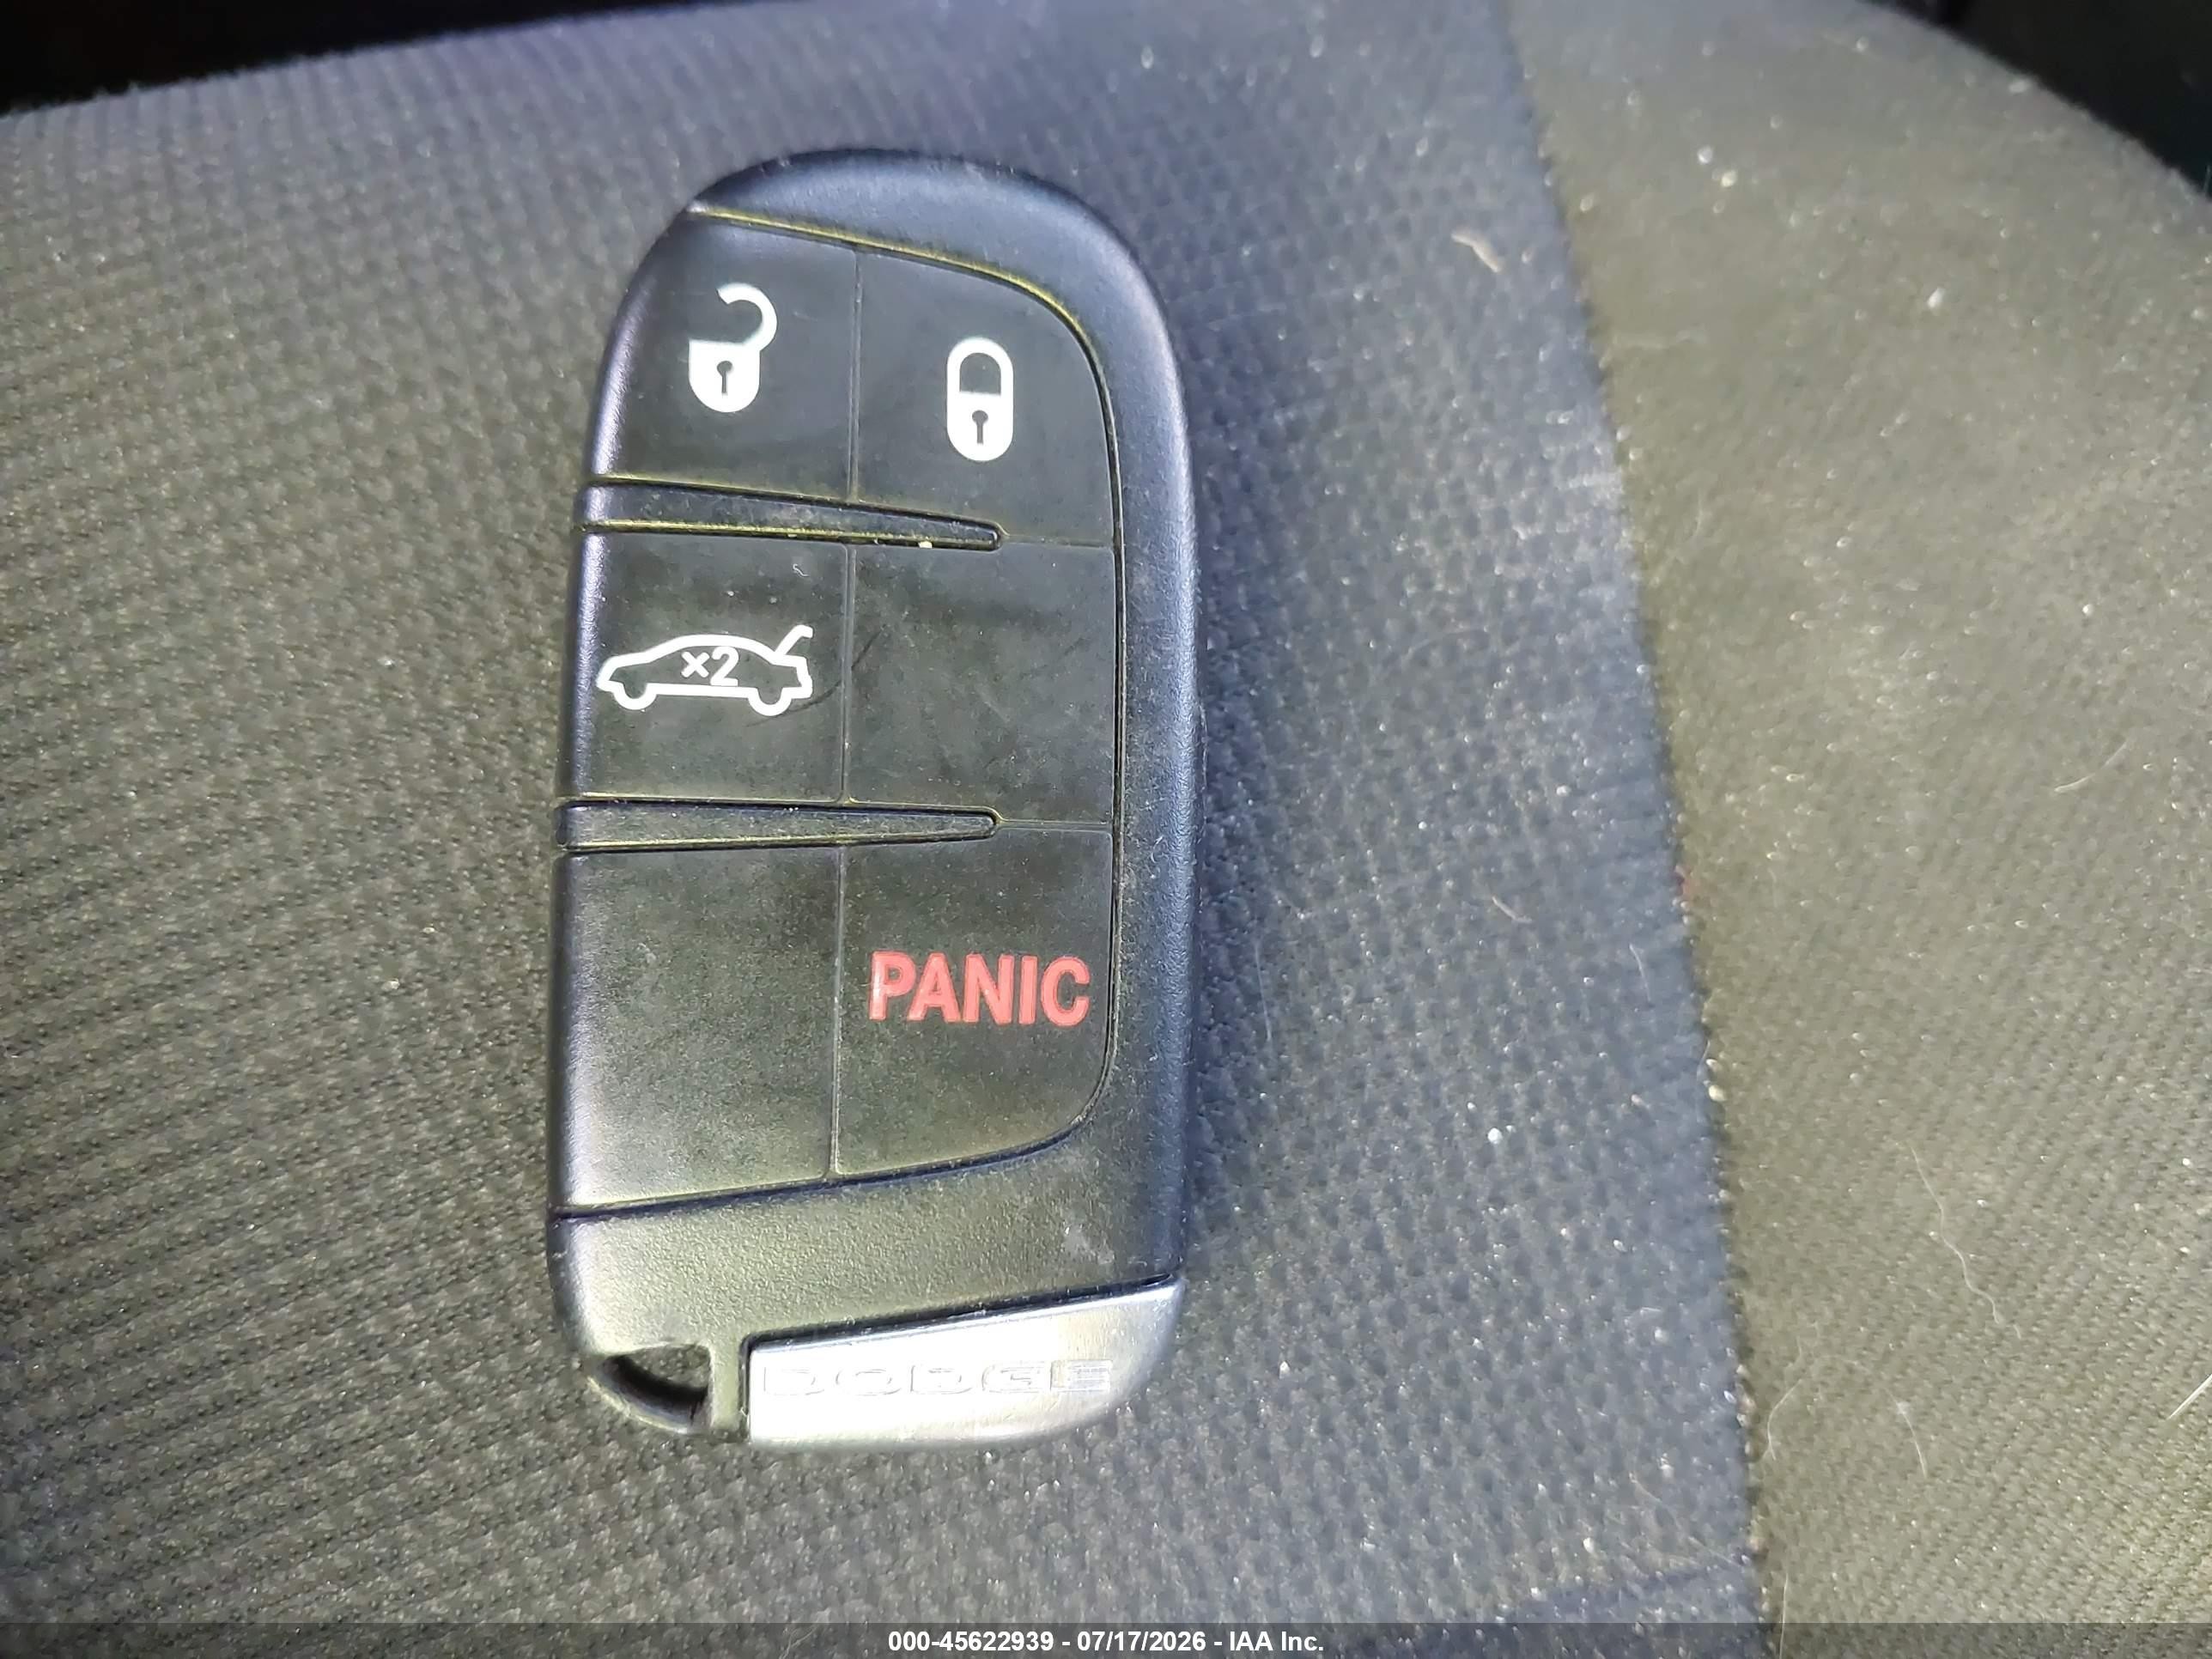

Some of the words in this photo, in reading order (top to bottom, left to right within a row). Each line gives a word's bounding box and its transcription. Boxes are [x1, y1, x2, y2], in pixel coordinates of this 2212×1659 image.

[681, 646, 739, 686] x2
[869, 951, 1091, 1026] PANIC
[763, 1359, 1113, 1396] DODGE
